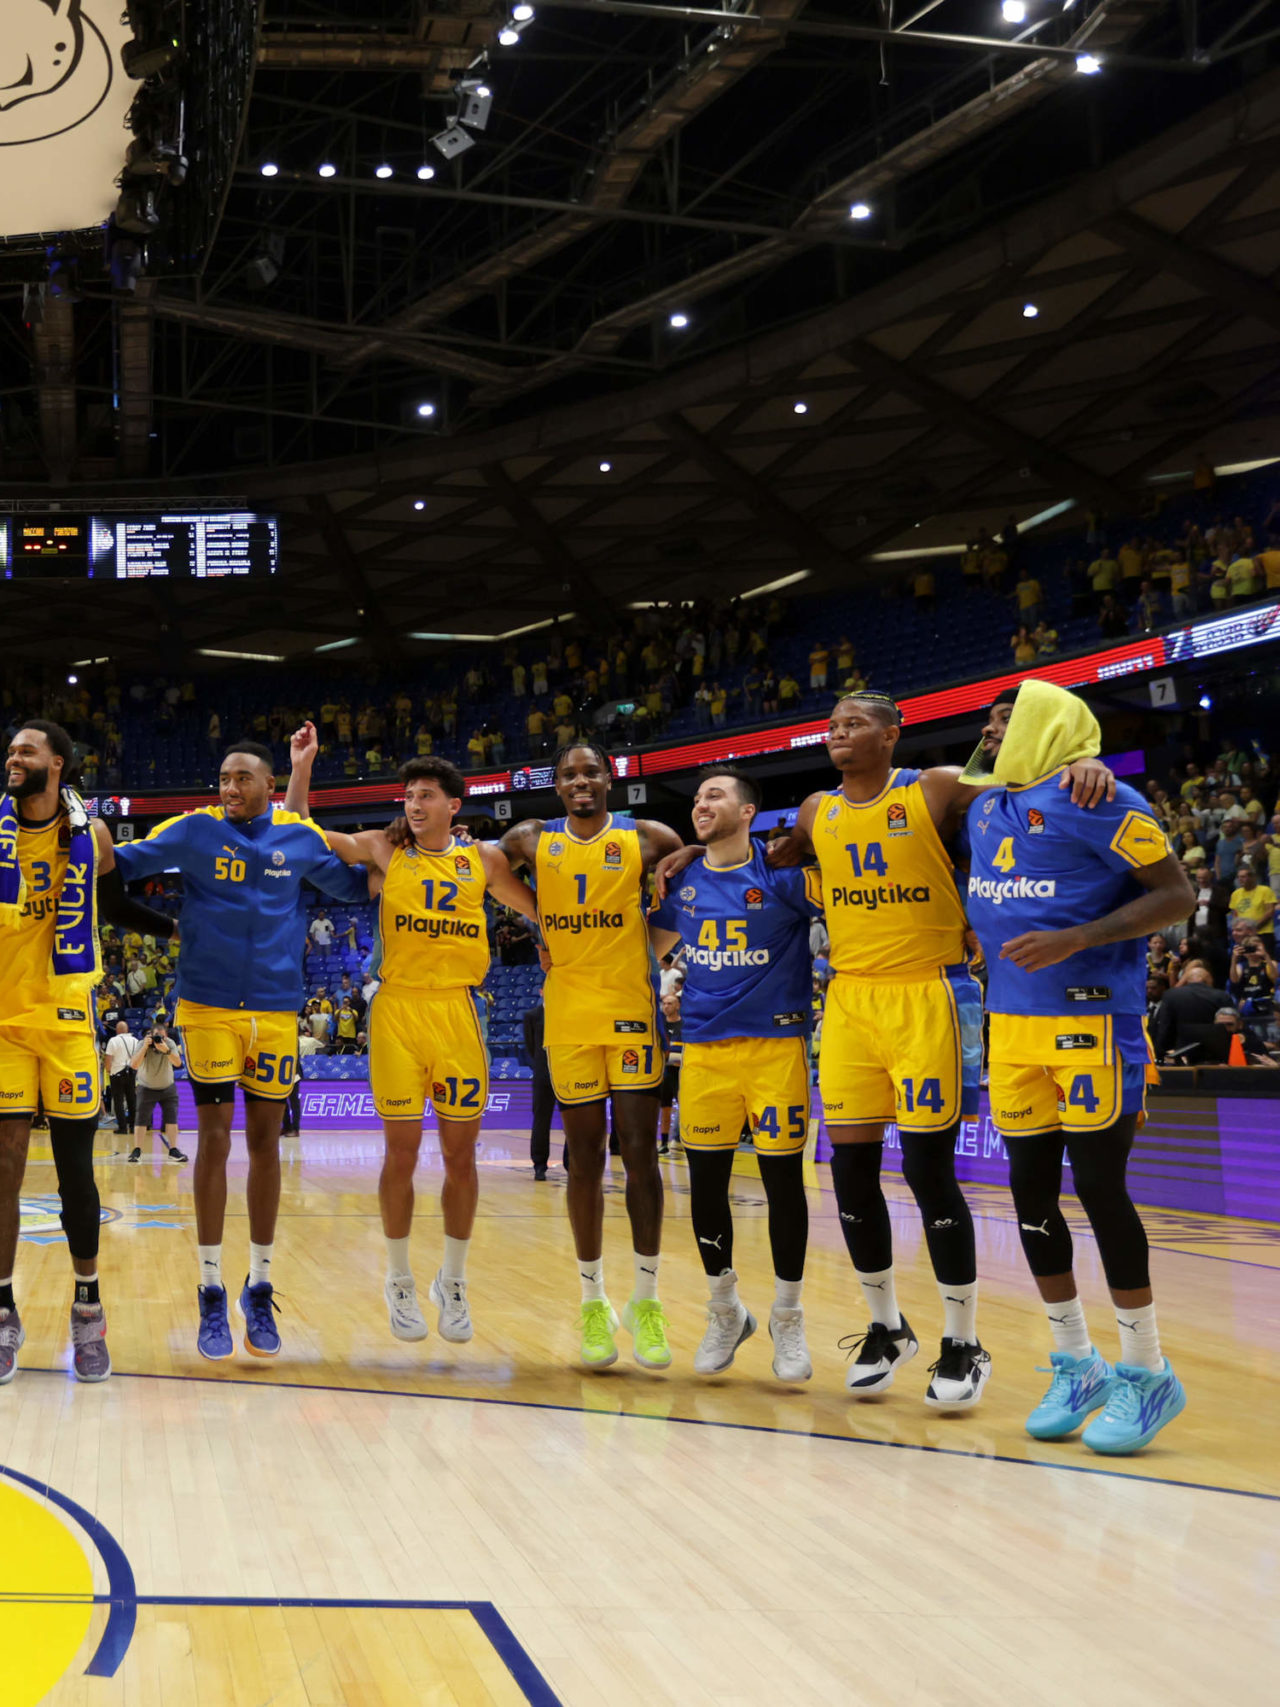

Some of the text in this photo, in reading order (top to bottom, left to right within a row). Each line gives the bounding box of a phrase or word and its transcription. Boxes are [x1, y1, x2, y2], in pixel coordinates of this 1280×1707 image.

[1156, 684, 1167, 701] 7
[632, 788, 641, 800] 7
[498, 804, 507, 816] 6
[121, 826, 130, 837] 6
[844, 841, 889, 878] 14
[991, 836, 1017, 873] 4
[31, 860, 52, 892] 3
[214, 857, 247, 882] 50
[263, 868, 292, 879] Playtika
[421, 879, 459, 912] 12
[573, 873, 588, 905] 1
[831, 882, 931, 911] Playtika
[967, 875, 1057, 905] Playtika
[55, 863, 88, 955] FUCK
[544, 908, 624, 935] Playtika
[395, 914, 480, 939] Playtika
[697, 919, 748, 952] 45
[684, 943, 770, 972] Playtika
[255, 1051, 295, 1086] 50
[74, 1071, 93, 1104] 3
[445, 1076, 481, 1108] 12
[574, 1079, 599, 1090] Rapyd
[901, 1077, 945, 1114] 14
[1068, 1073, 1100, 1114] 4
[301, 1092, 376, 1117] GAME
[385, 1097, 412, 1109] Rapyd
[822, 1101, 844, 1111] apyd
[1000, 1106, 1033, 1120] Rapyd
[692, 1124, 721, 1135] Rapyd
[758, 1104, 805, 1140] 45
